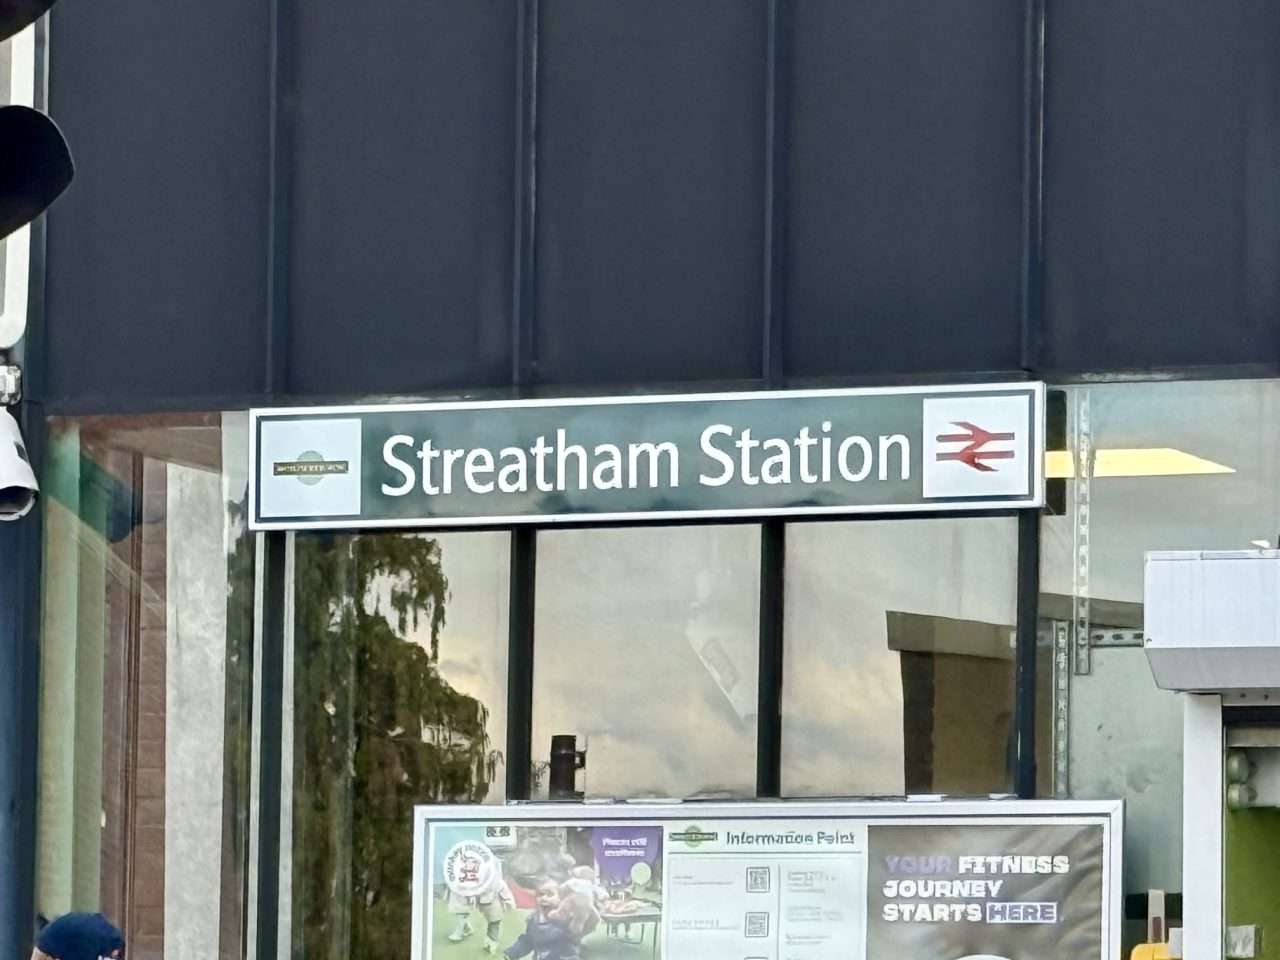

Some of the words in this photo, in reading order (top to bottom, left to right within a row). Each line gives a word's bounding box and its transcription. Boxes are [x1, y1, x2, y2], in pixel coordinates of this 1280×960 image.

[381, 427, 680, 497] Streatham
[698, 420, 911, 487] Station
[726, 831, 814, 845] Information
[817, 831, 855, 845] Point
[885, 855, 952, 874] YOUR
[958, 855, 1070, 874] FITNESS
[882, 879, 1004, 898] JOURNEY
[882, 903, 983, 922] STARTS
[987, 903, 1057, 922] HERE
